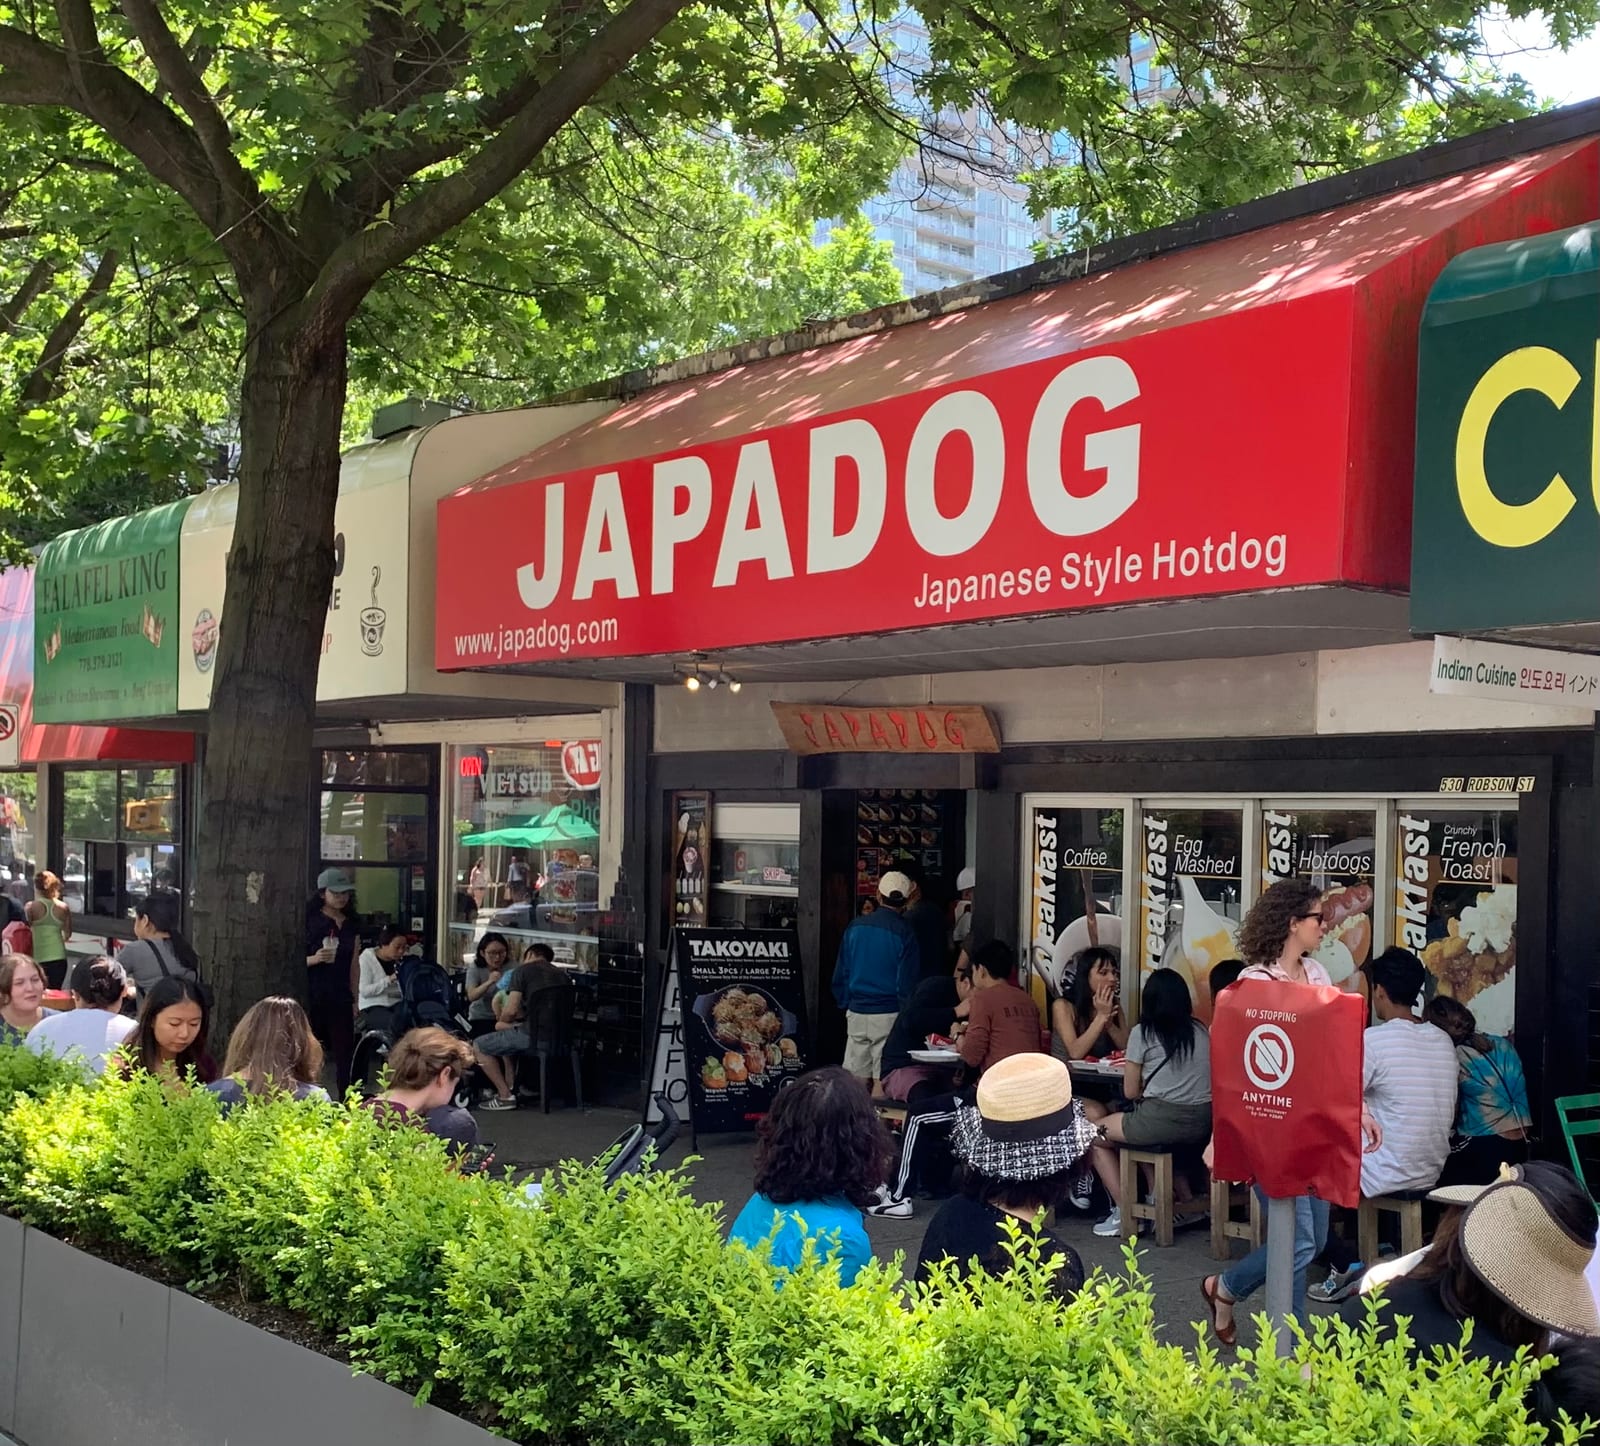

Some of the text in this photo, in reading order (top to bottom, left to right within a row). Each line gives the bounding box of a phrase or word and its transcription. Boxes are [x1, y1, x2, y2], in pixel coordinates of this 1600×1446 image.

[1455, 339, 1600, 548] C
[516, 354, 1142, 610] JAPADOG
[43, 548, 167, 615] FALAFEL KING
[914, 531, 1287, 613] Japanese Style Hotdog
[455, 617, 618, 659] www.japadog.com
[1437, 657, 1473, 682] Indian
[1476, 662, 1517, 687] Cuisine
[1520, 667, 1566, 693] 인도요리
[800, 711, 965, 750] JAPADOG
[460, 756, 482, 777] OPEN
[1441, 777, 1534, 792] 530 ROBSON ST
[1443, 825, 1478, 837] Crunchy
[1064, 847, 1107, 867] Coffee
[1174, 834, 1202, 857] Egg
[1440, 836, 1506, 859] French
[1174, 855, 1235, 875] Mashed
[1299, 850, 1371, 874] Hotdogs
[1442, 857, 1492, 880] Toast
[689, 939, 788, 957] TAKOYAKI
[692, 967, 716, 975] SMALL
[745, 967, 770, 975] LARGE
[1245, 1008, 1297, 1023] NO STOPPING
[1242, 1091, 1292, 1108] ANYTIME
